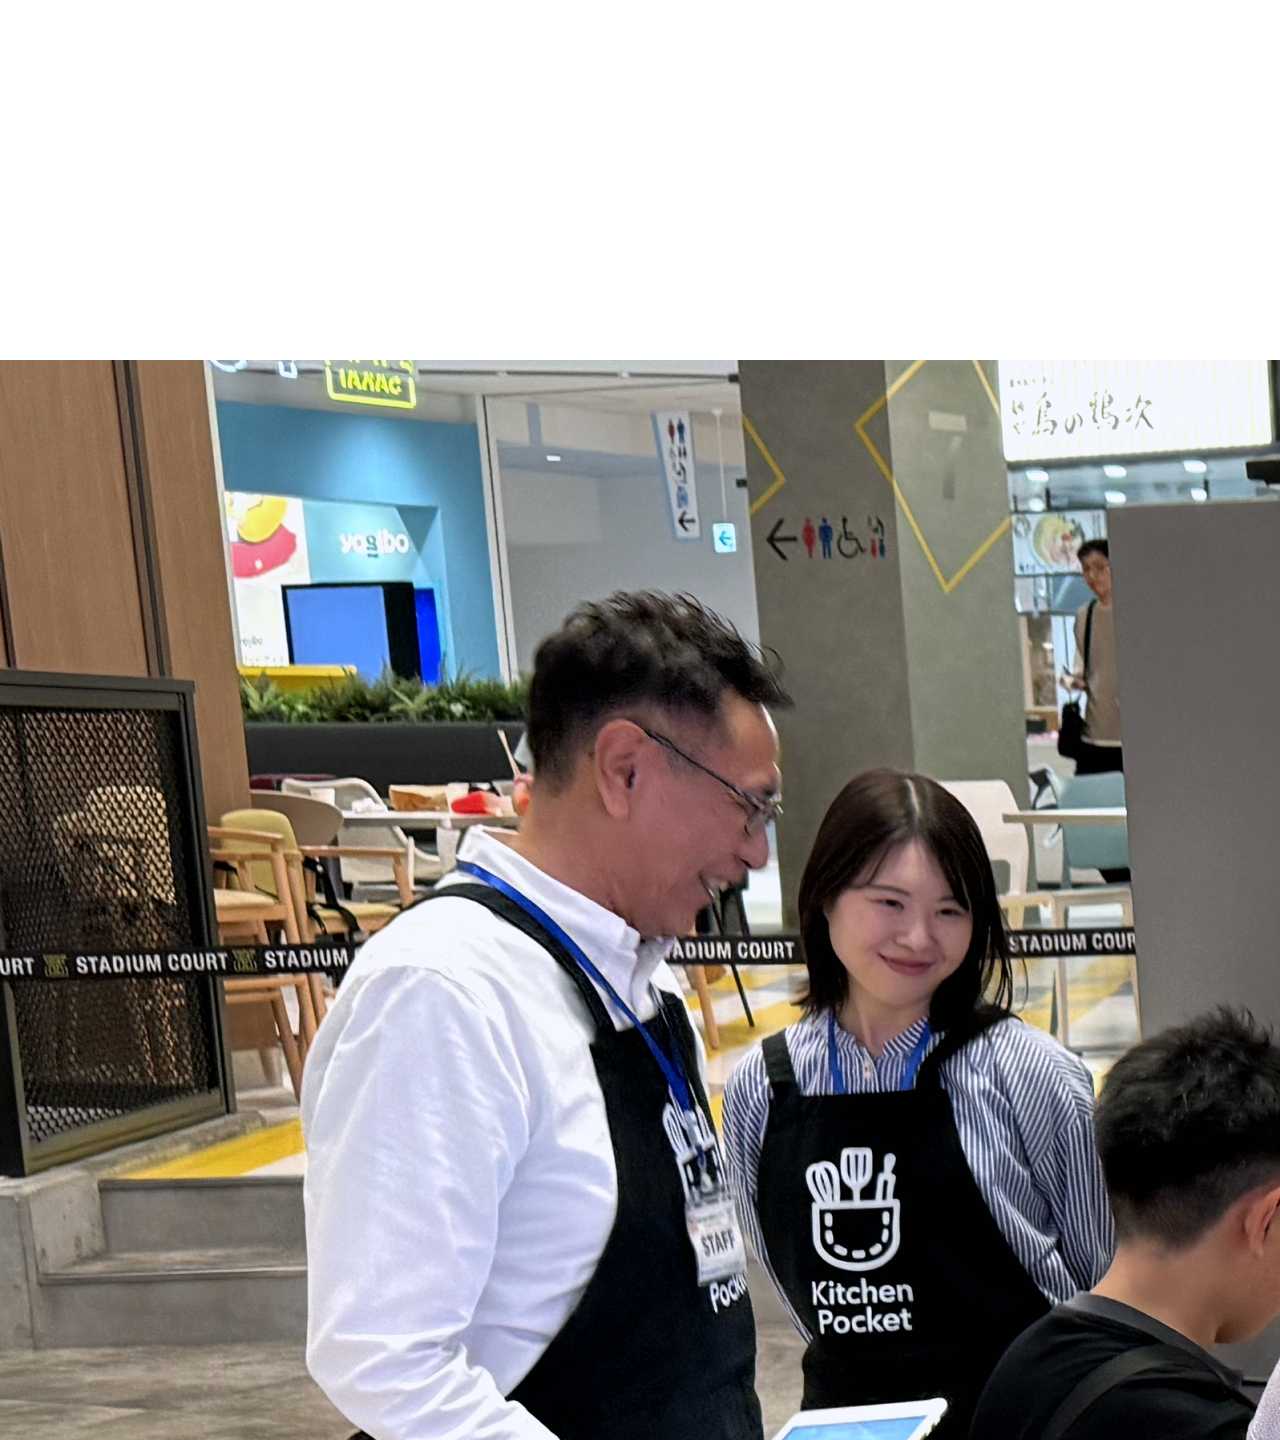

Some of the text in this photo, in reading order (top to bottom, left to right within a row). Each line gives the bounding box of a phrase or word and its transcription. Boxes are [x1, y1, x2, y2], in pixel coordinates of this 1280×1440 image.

[668, 940, 796, 961] ADIUM COURT
[1008, 931, 1136, 954] STADIUM COUR
[76, 953, 162, 974] STADIUM
[167, 951, 228, 972] COURT
[265, 948, 349, 969] STADIUM
[701, 1229, 736, 1258] STAFF
[810, 1278, 914, 1308] Kitchen
[817, 1305, 913, 1335] Pocket
